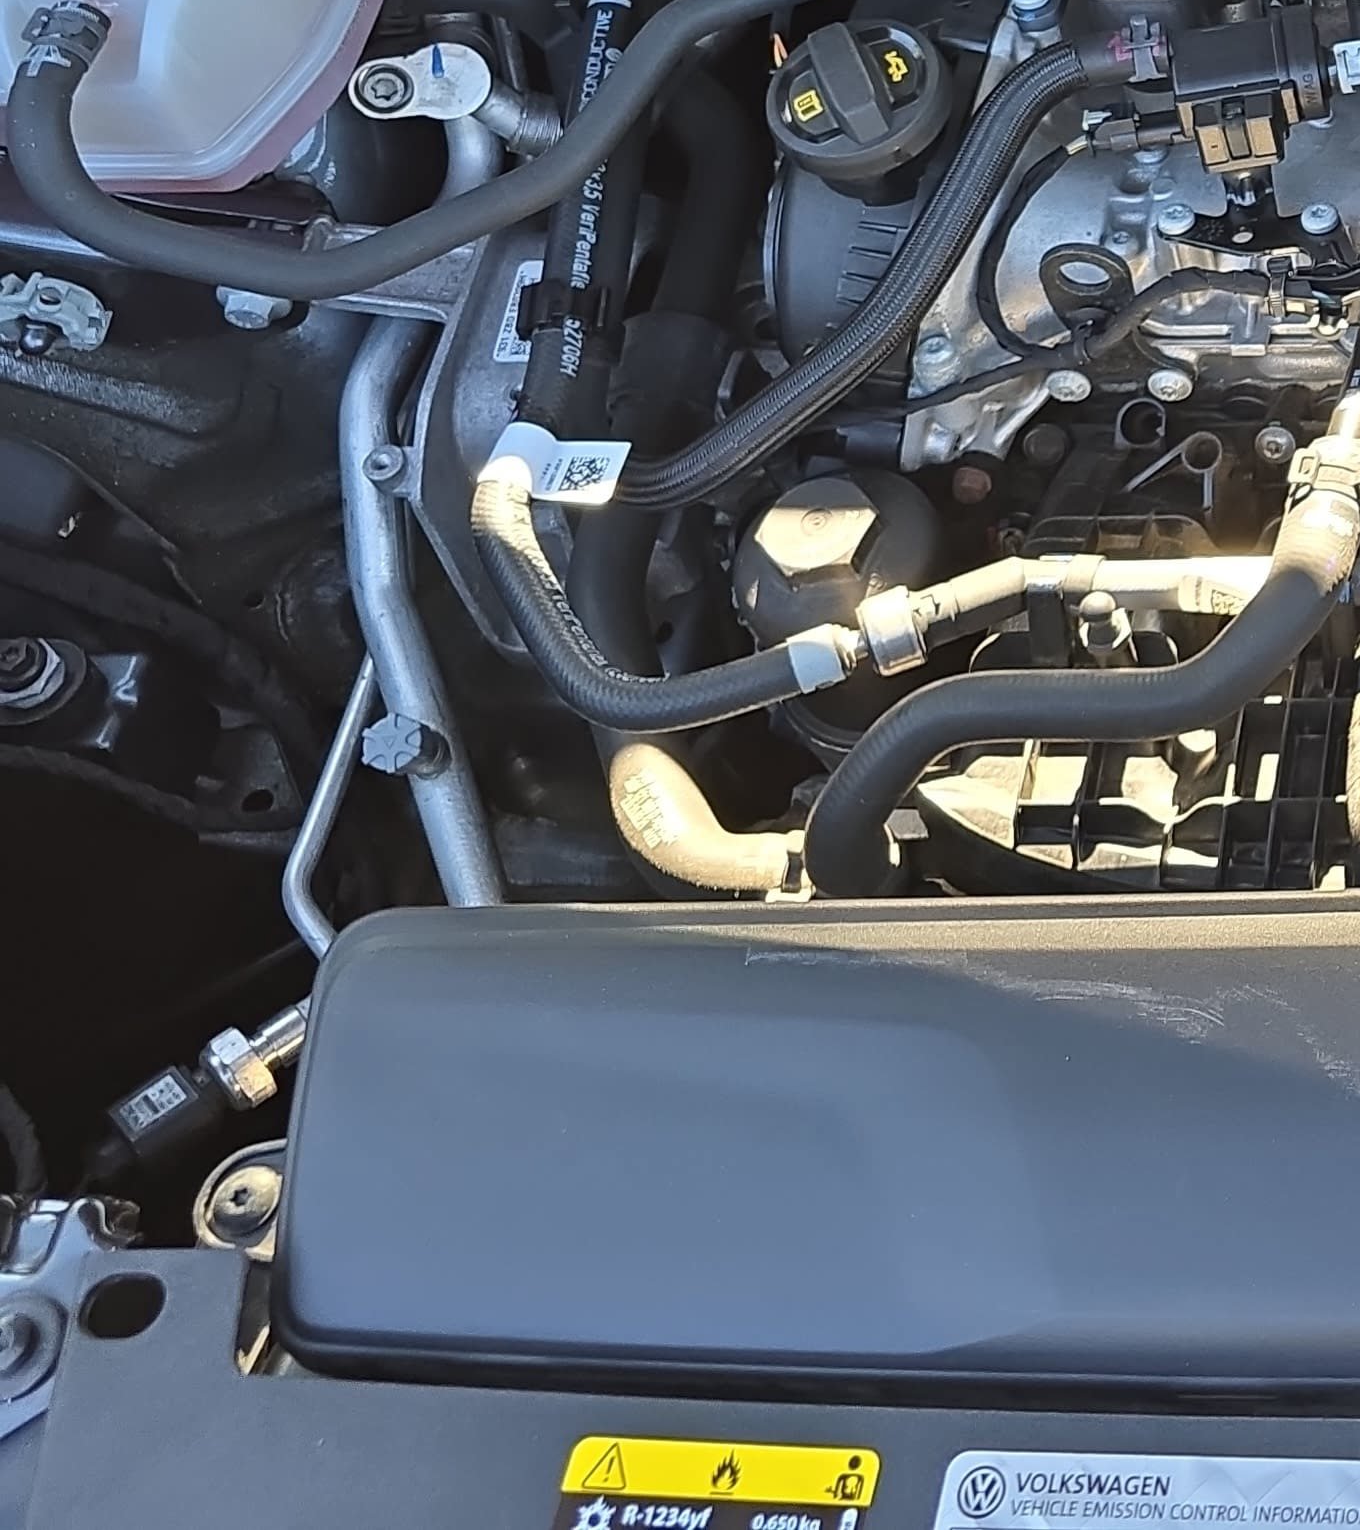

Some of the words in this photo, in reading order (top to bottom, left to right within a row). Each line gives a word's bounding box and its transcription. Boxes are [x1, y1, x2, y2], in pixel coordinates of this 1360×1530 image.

[1016, 1472, 1170, 1496] VOLKSWAGEN
[620, 1504, 714, 1530] R-1234yf
[1010, 1499, 1079, 1517] VEHICLE
[1083, 1501, 1165, 1519] EMISSION
[1170, 1503, 1248, 1522] CONTROL
